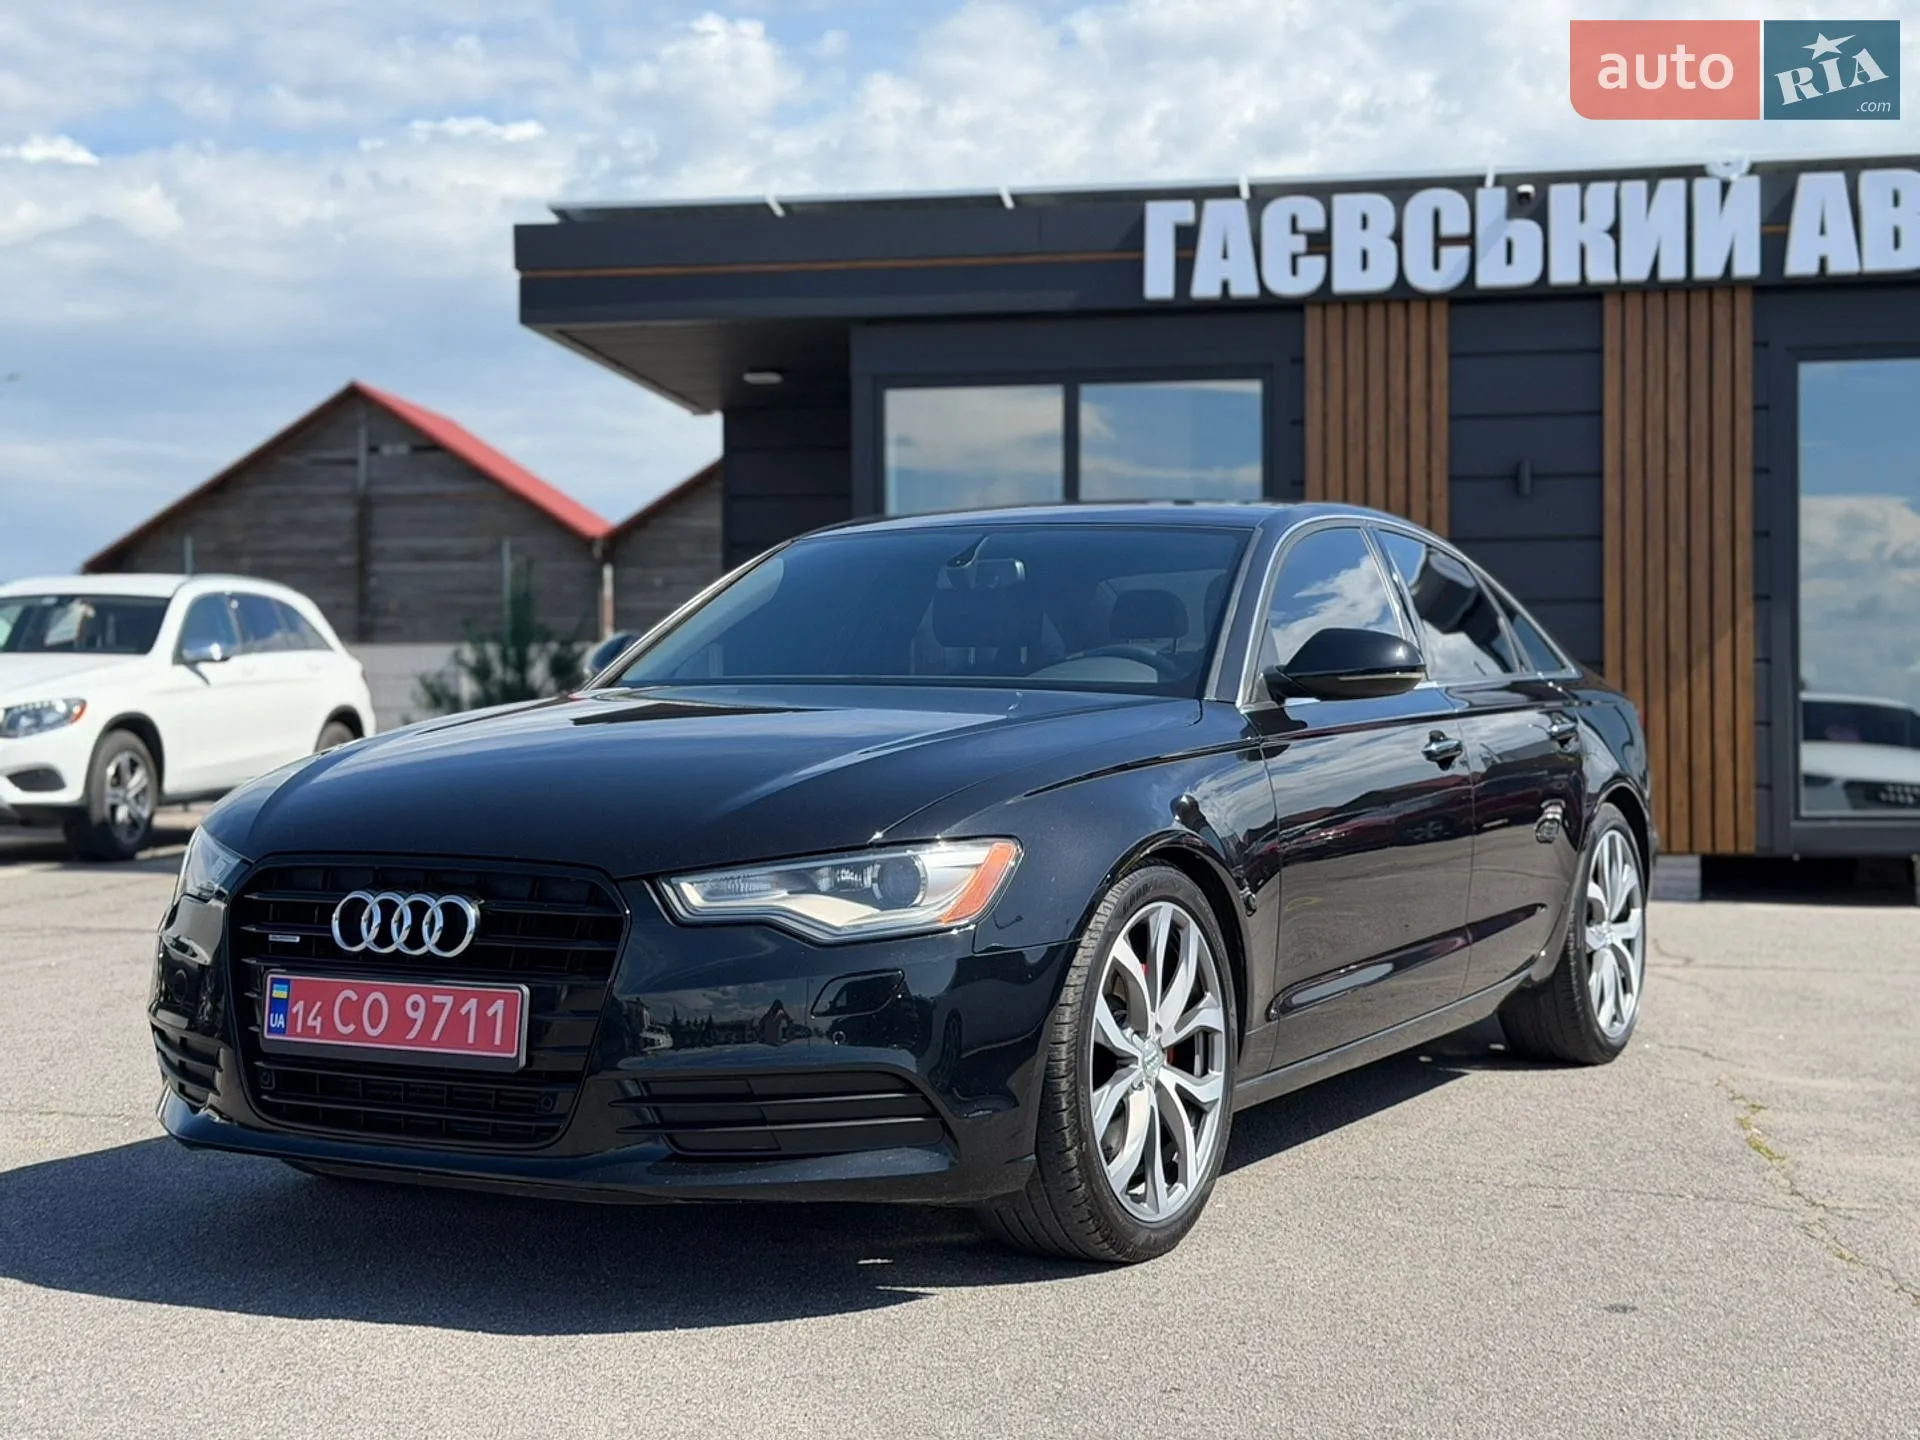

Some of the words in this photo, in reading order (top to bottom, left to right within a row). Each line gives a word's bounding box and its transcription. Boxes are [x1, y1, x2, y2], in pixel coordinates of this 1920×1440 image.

[1143, 157, 1761, 300] ГАЄВСЬКИЙ
[269, 1013, 285, 1029] UA
[292, 1000, 322, 1035] 14
[333, 989, 389, 1037] CO
[405, 994, 504, 1045] 9711
